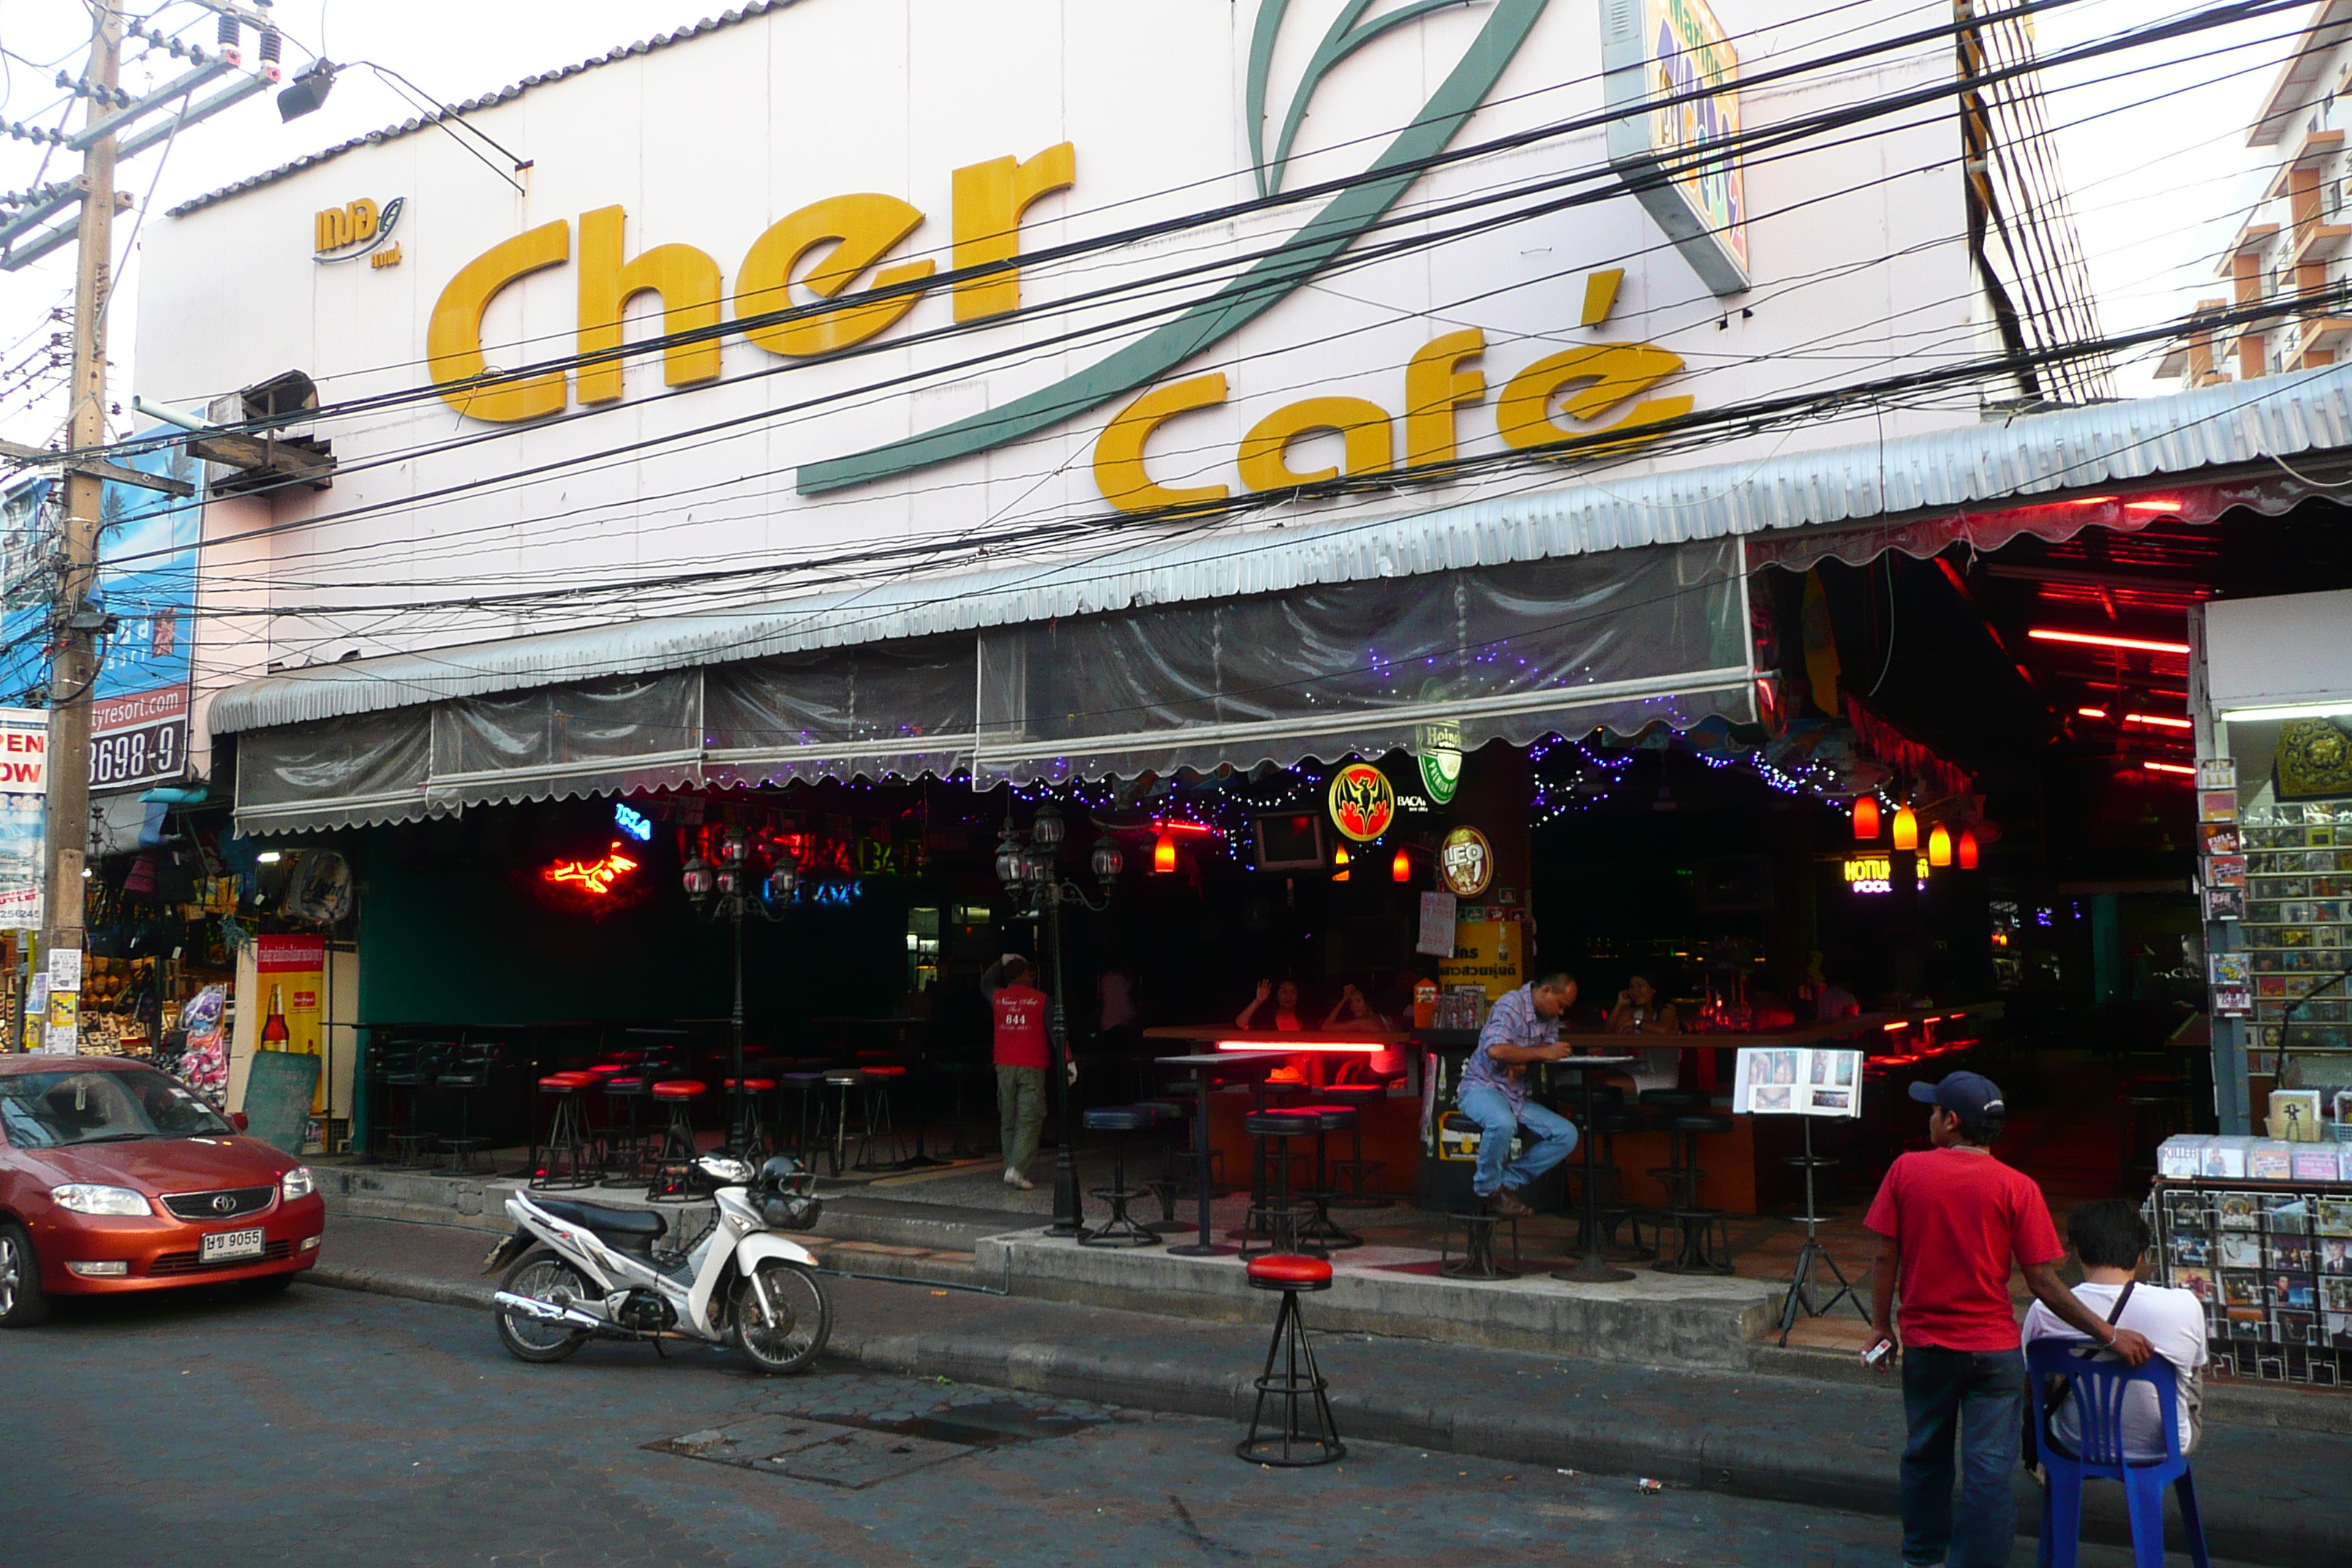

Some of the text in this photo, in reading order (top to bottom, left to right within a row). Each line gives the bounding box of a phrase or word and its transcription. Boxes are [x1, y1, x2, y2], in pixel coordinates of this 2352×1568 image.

[427, 141, 1074, 422] Cher
[1093, 267, 1695, 520] Café
[1444, 842, 1483, 867] LEO
[1853, 880, 1892, 893] POOL
[1006, 1014, 1025, 1025] 844
[229, 1231, 260, 1246] 9055
